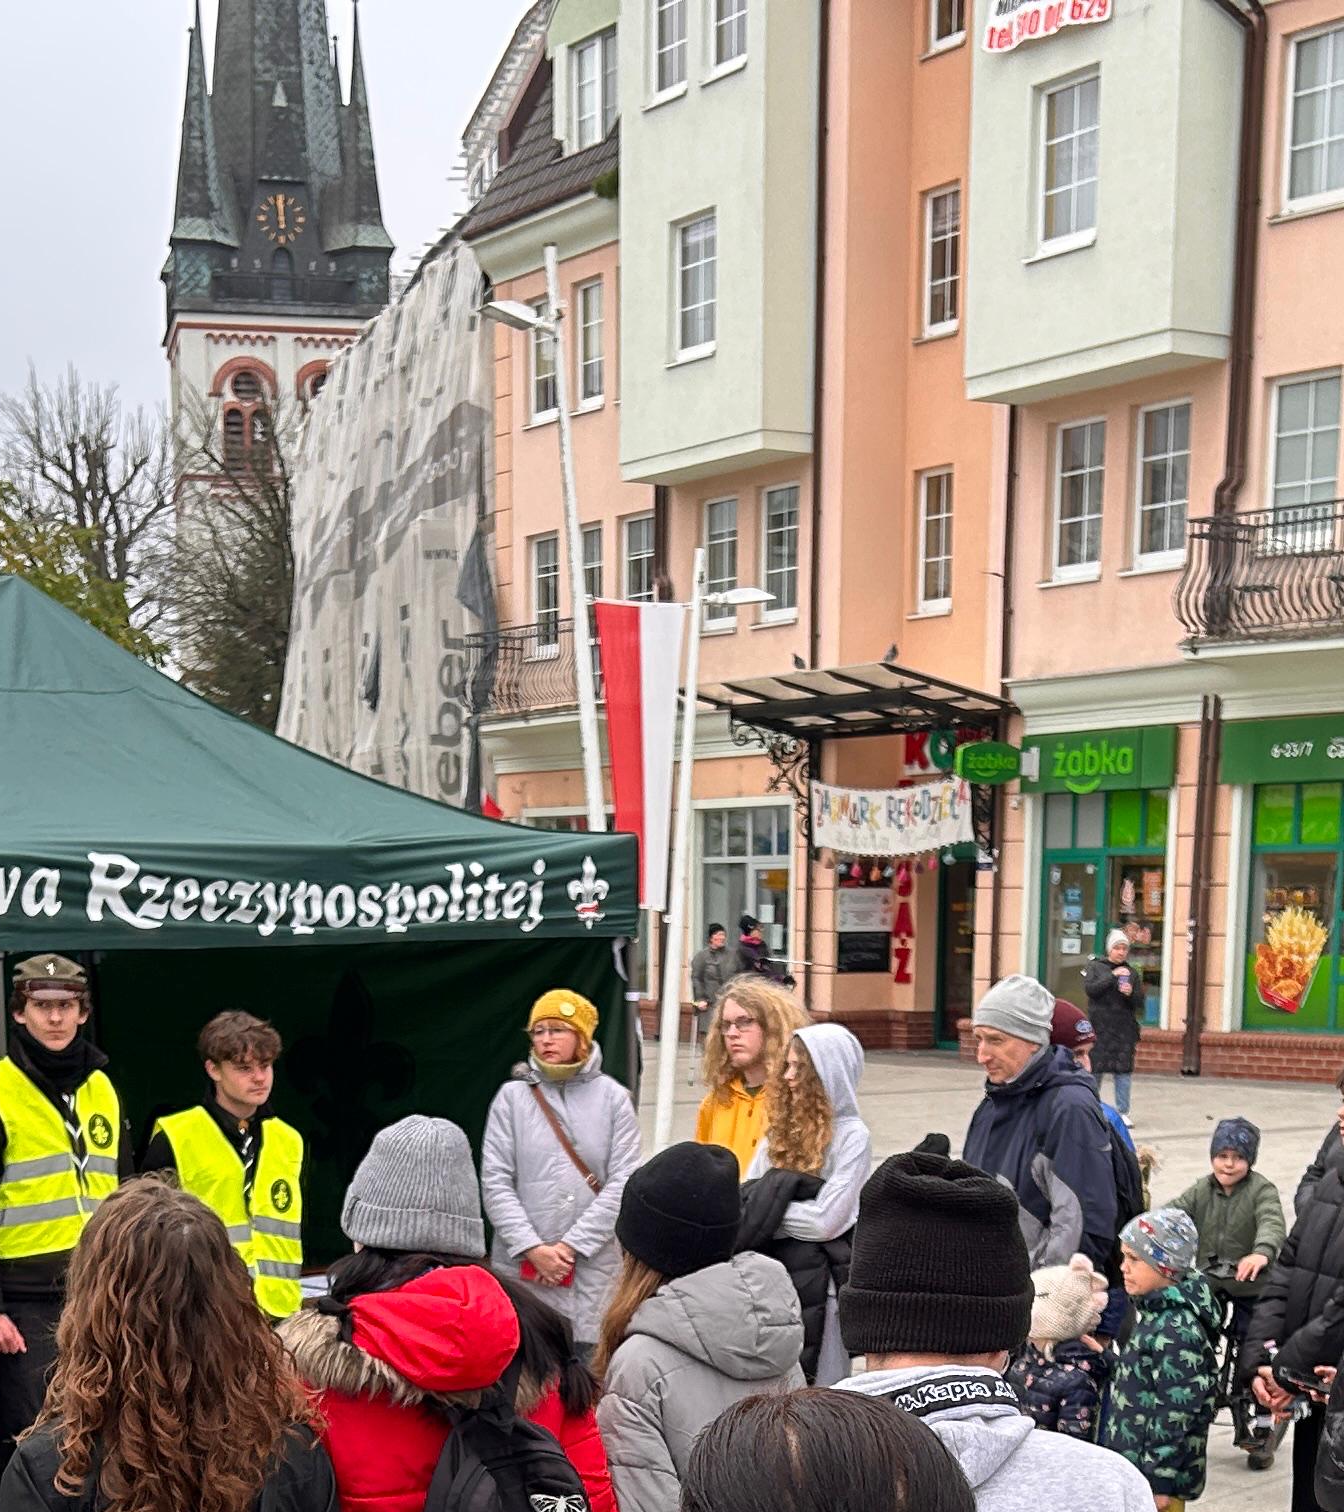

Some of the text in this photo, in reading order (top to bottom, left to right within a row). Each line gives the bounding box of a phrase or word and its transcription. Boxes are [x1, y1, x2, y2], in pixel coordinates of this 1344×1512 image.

[428, 619, 465, 799] eber
[1053, 741, 1134, 777] żabka
[85, 851, 548, 937] Rzeczypospolitej
[917, 1380, 991, 1406] Kappa
